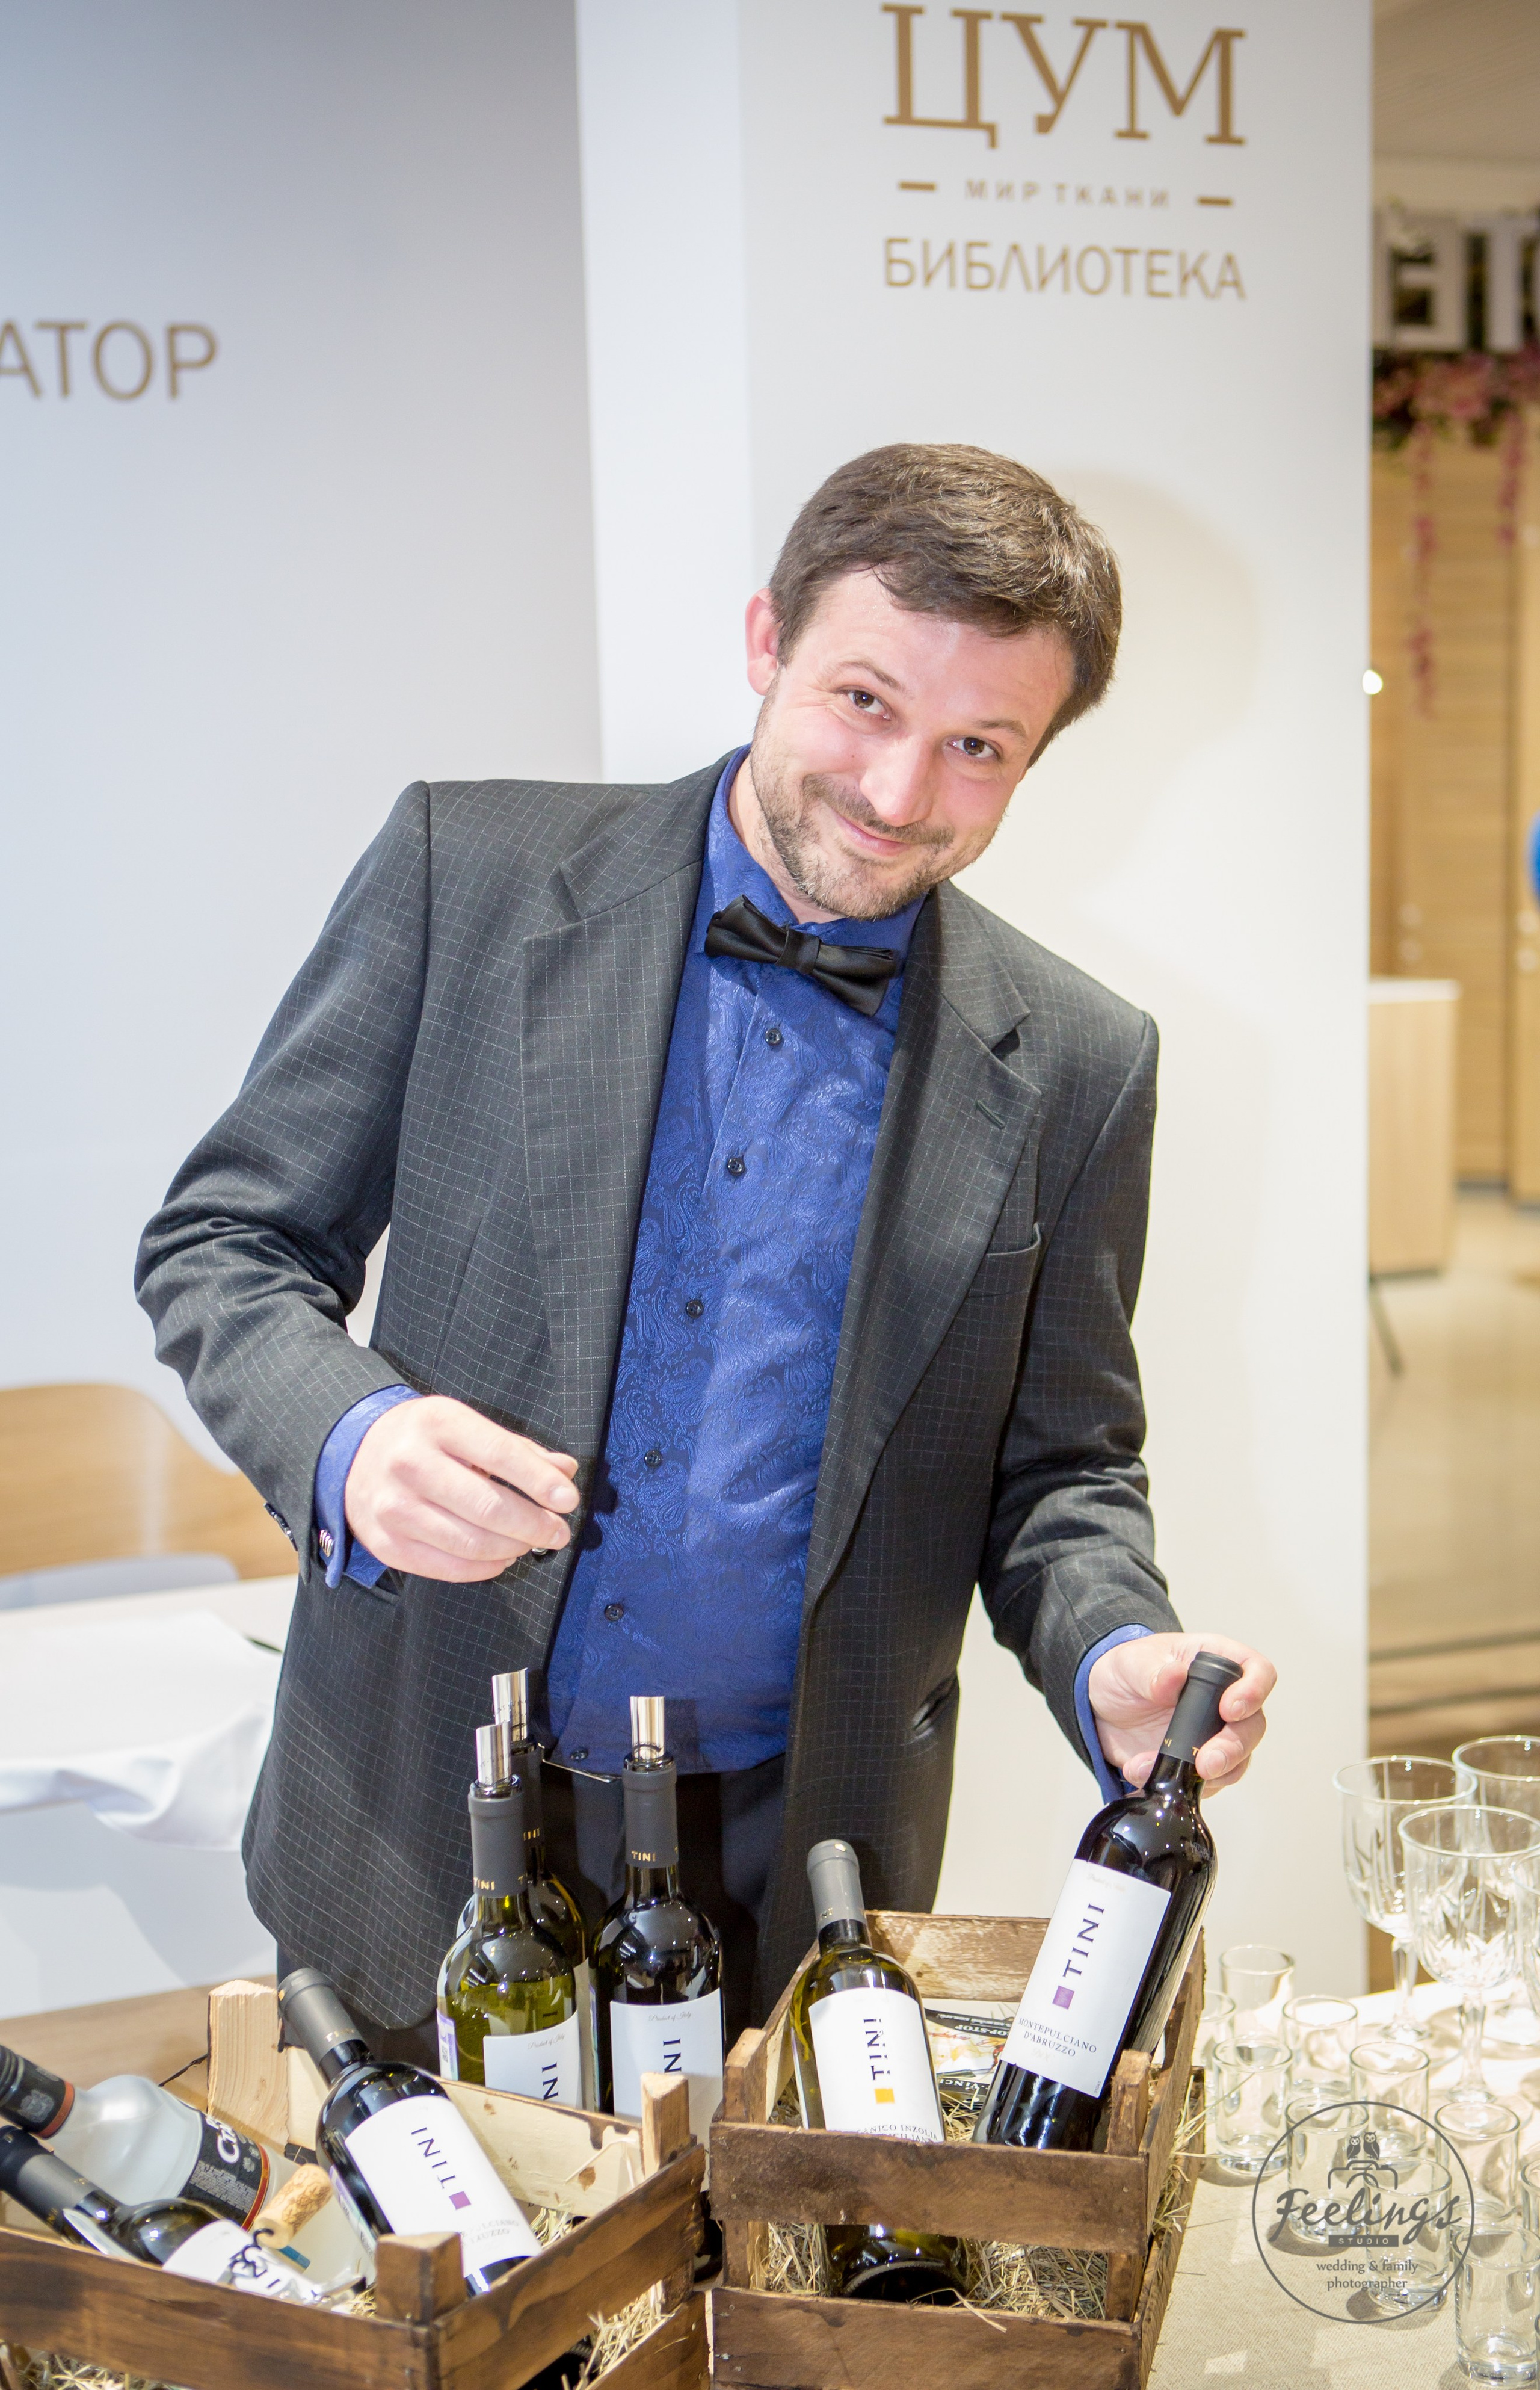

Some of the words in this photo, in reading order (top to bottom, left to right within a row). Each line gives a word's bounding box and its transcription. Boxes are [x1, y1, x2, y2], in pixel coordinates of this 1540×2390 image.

[881, 3, 1246, 149] ЦУМ
[966, 180, 1040, 202] МИР
[1055, 182, 1170, 208] ТКАНИ
[884, 237, 1247, 301] БИБЛИОТЕКА
[631, 1850, 656, 1862] TINI
[473, 1876, 495, 1891] TINI
[1062, 1903, 1105, 1978] TINI
[863, 2018, 890, 2081] TINI
[1018, 2017, 1097, 2054] MONTEPULCIANO
[1024, 2031, 1076, 2057] D'ABRUZZO
[901, 2125, 938, 2141] INZOLIA
[410, 2127, 456, 2190] TINI
